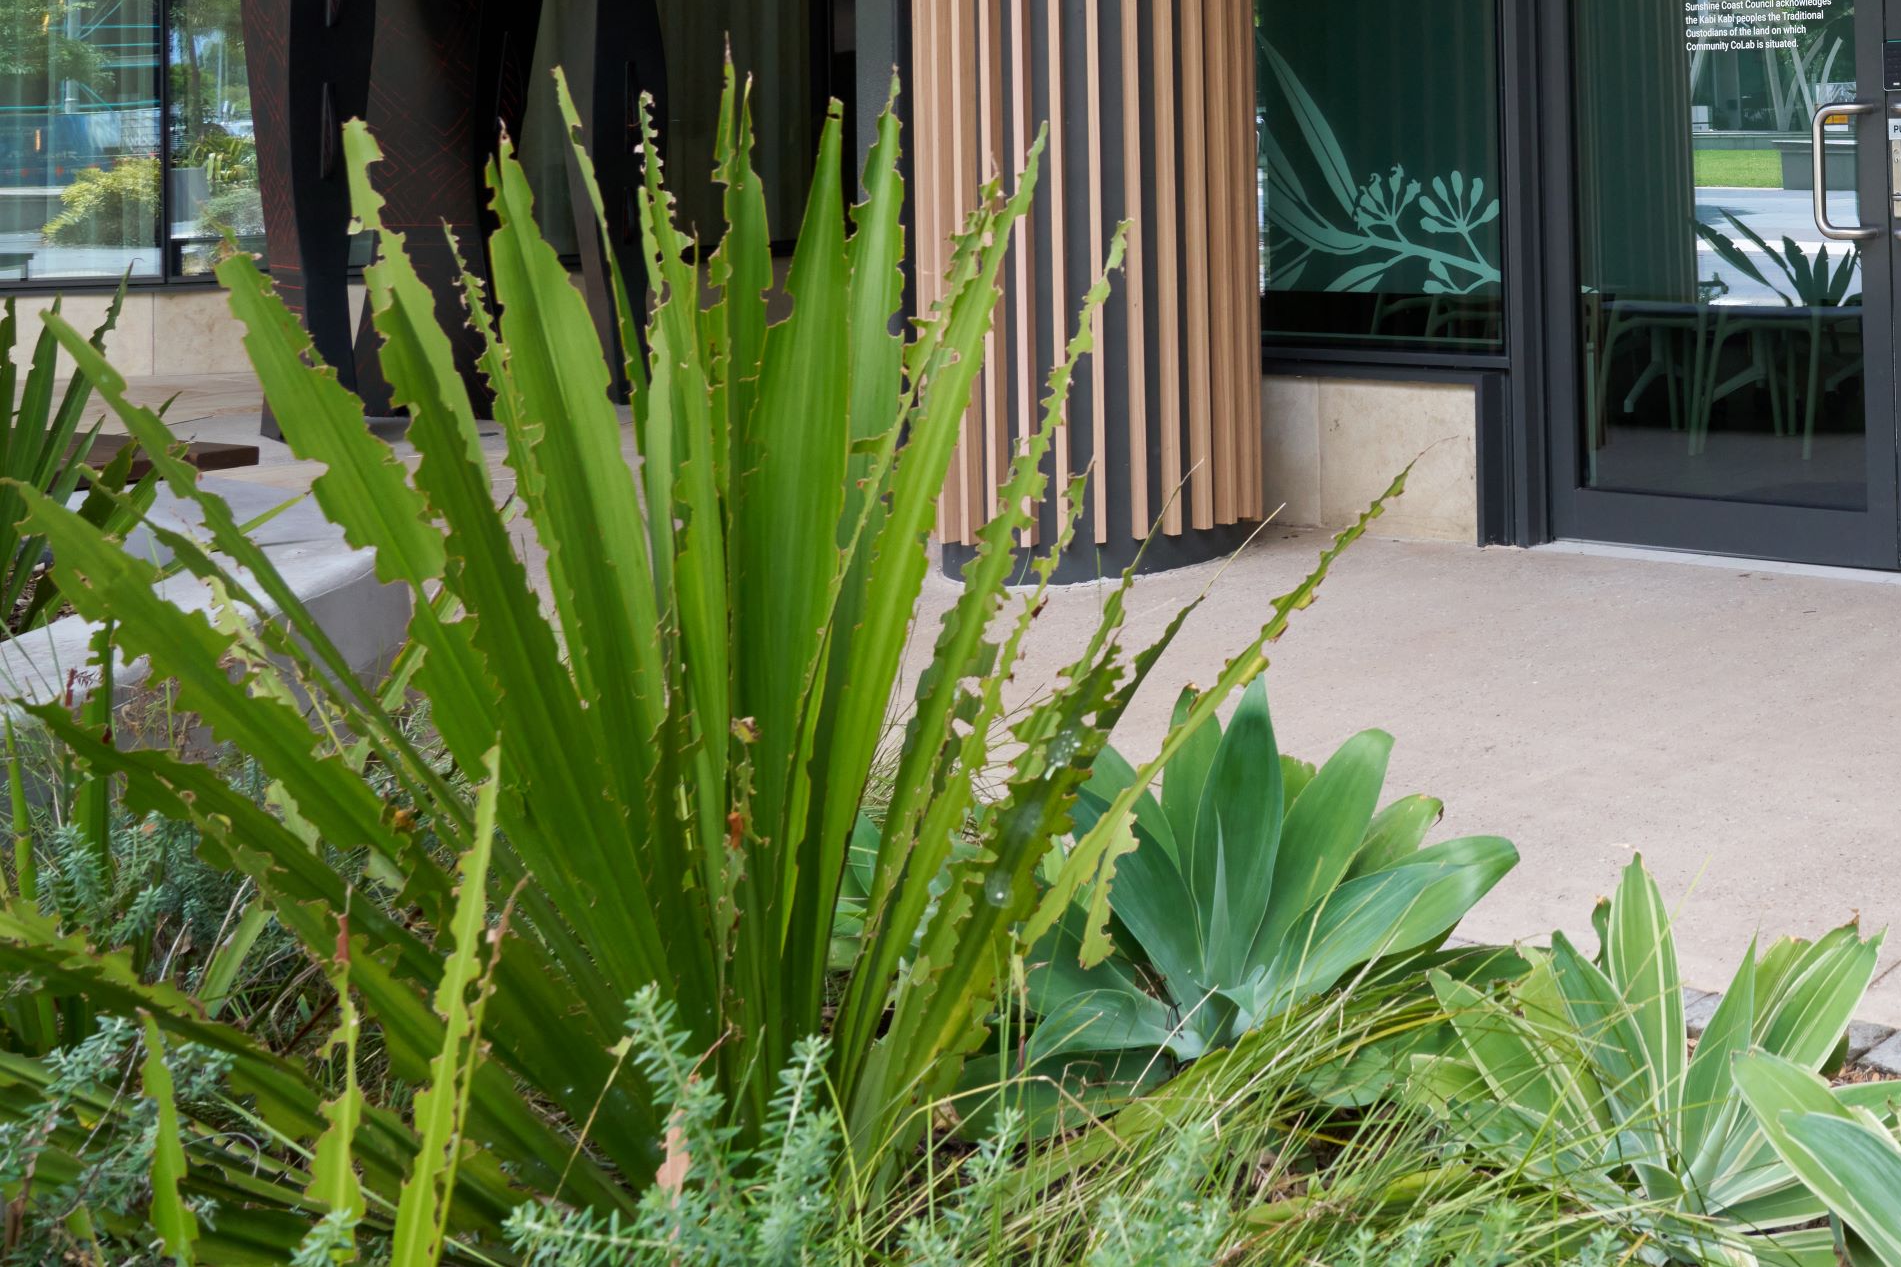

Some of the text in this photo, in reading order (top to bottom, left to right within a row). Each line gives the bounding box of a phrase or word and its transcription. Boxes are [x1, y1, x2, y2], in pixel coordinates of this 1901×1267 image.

[1685, 3, 1720, 12] Sunshine
[1721, 0, 1744, 10] Coast
[1685, 10, 1824, 25] the Kabi Kabi peoples the Traditional
[1685, 24, 1807, 38] Custodians of the land on which
[1686, 38, 1799, 52] Community CoLab is situated.
